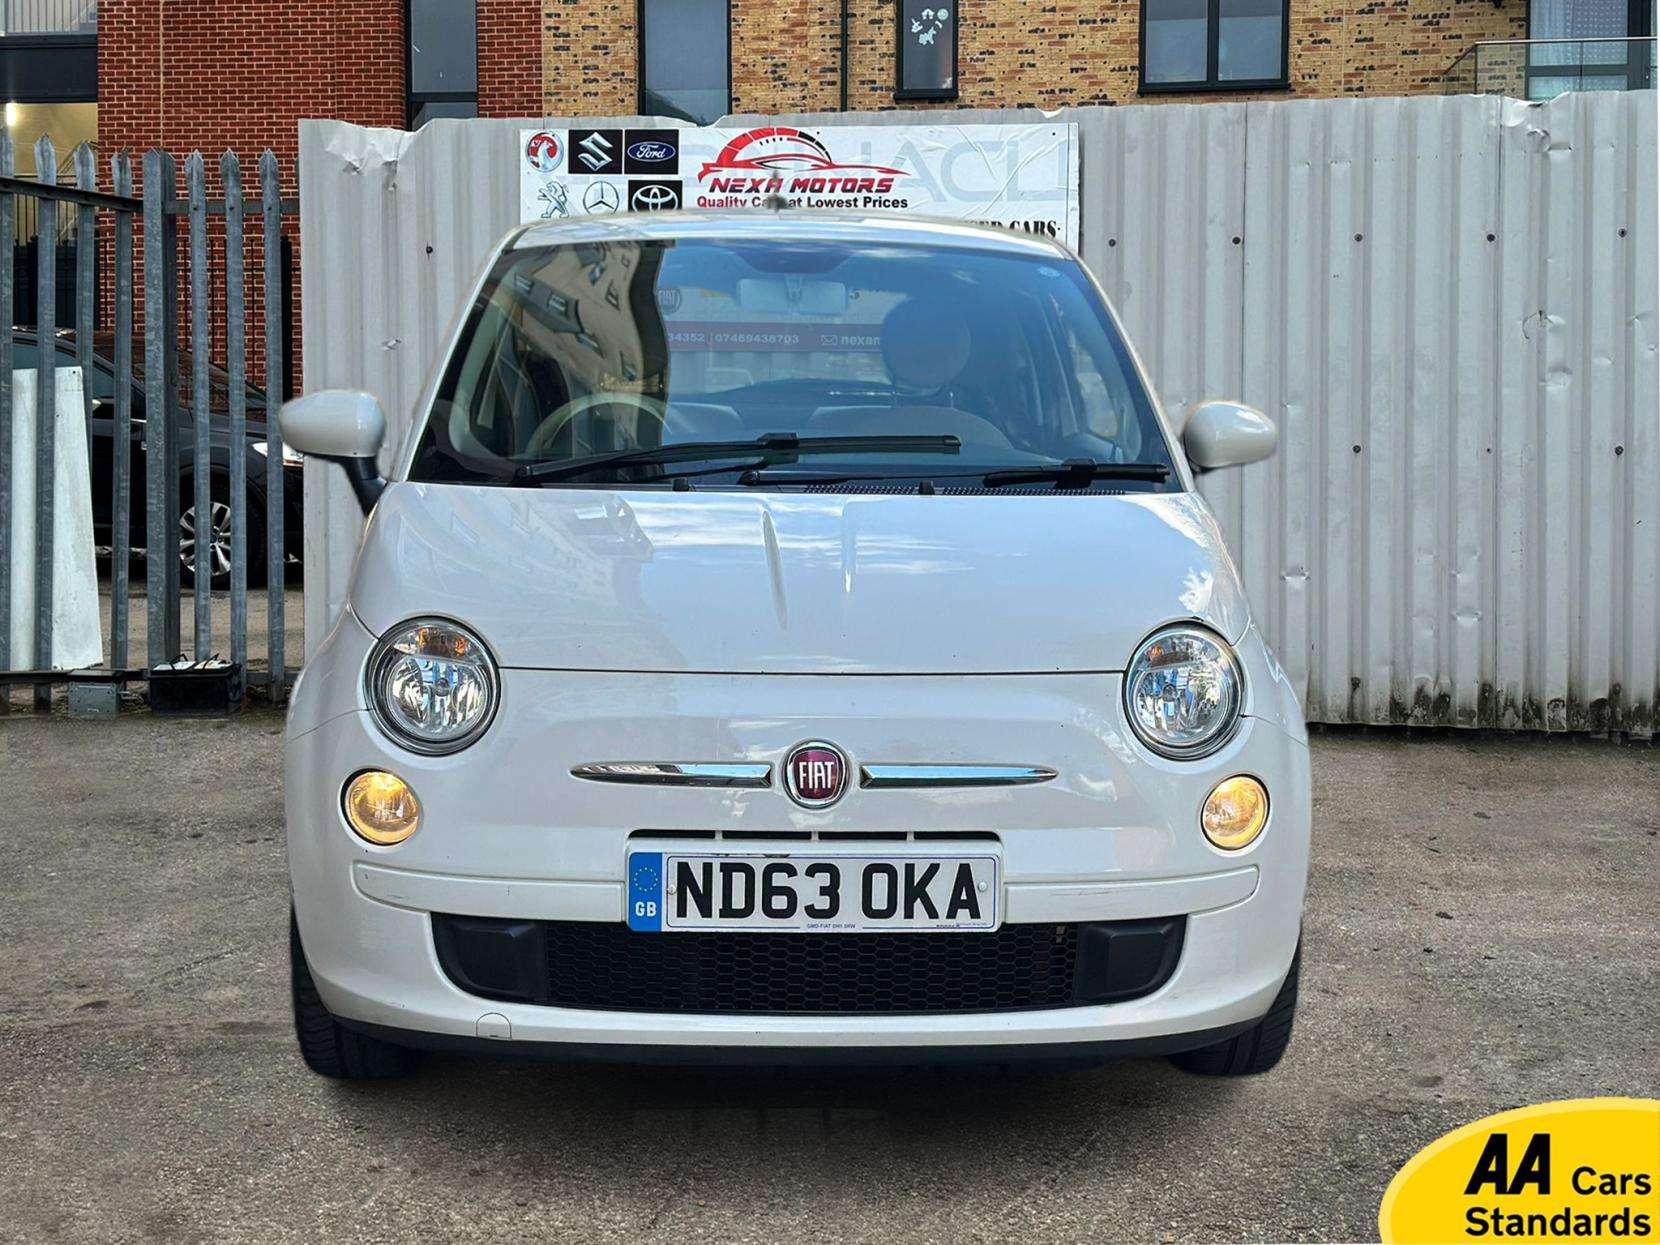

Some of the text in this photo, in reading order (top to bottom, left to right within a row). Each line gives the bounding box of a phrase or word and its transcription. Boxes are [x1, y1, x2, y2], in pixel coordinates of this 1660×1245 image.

[636, 143, 666, 159] Ford
[708, 177, 894, 194] NEXA MOTORS
[697, 195, 747, 208] Quality
[807, 195, 859, 208] Lowest
[863, 195, 909, 208] Prices
[799, 761, 834, 789] FIAT
[676, 861, 982, 920] ND63 OKA
[635, 901, 657, 917] GB
